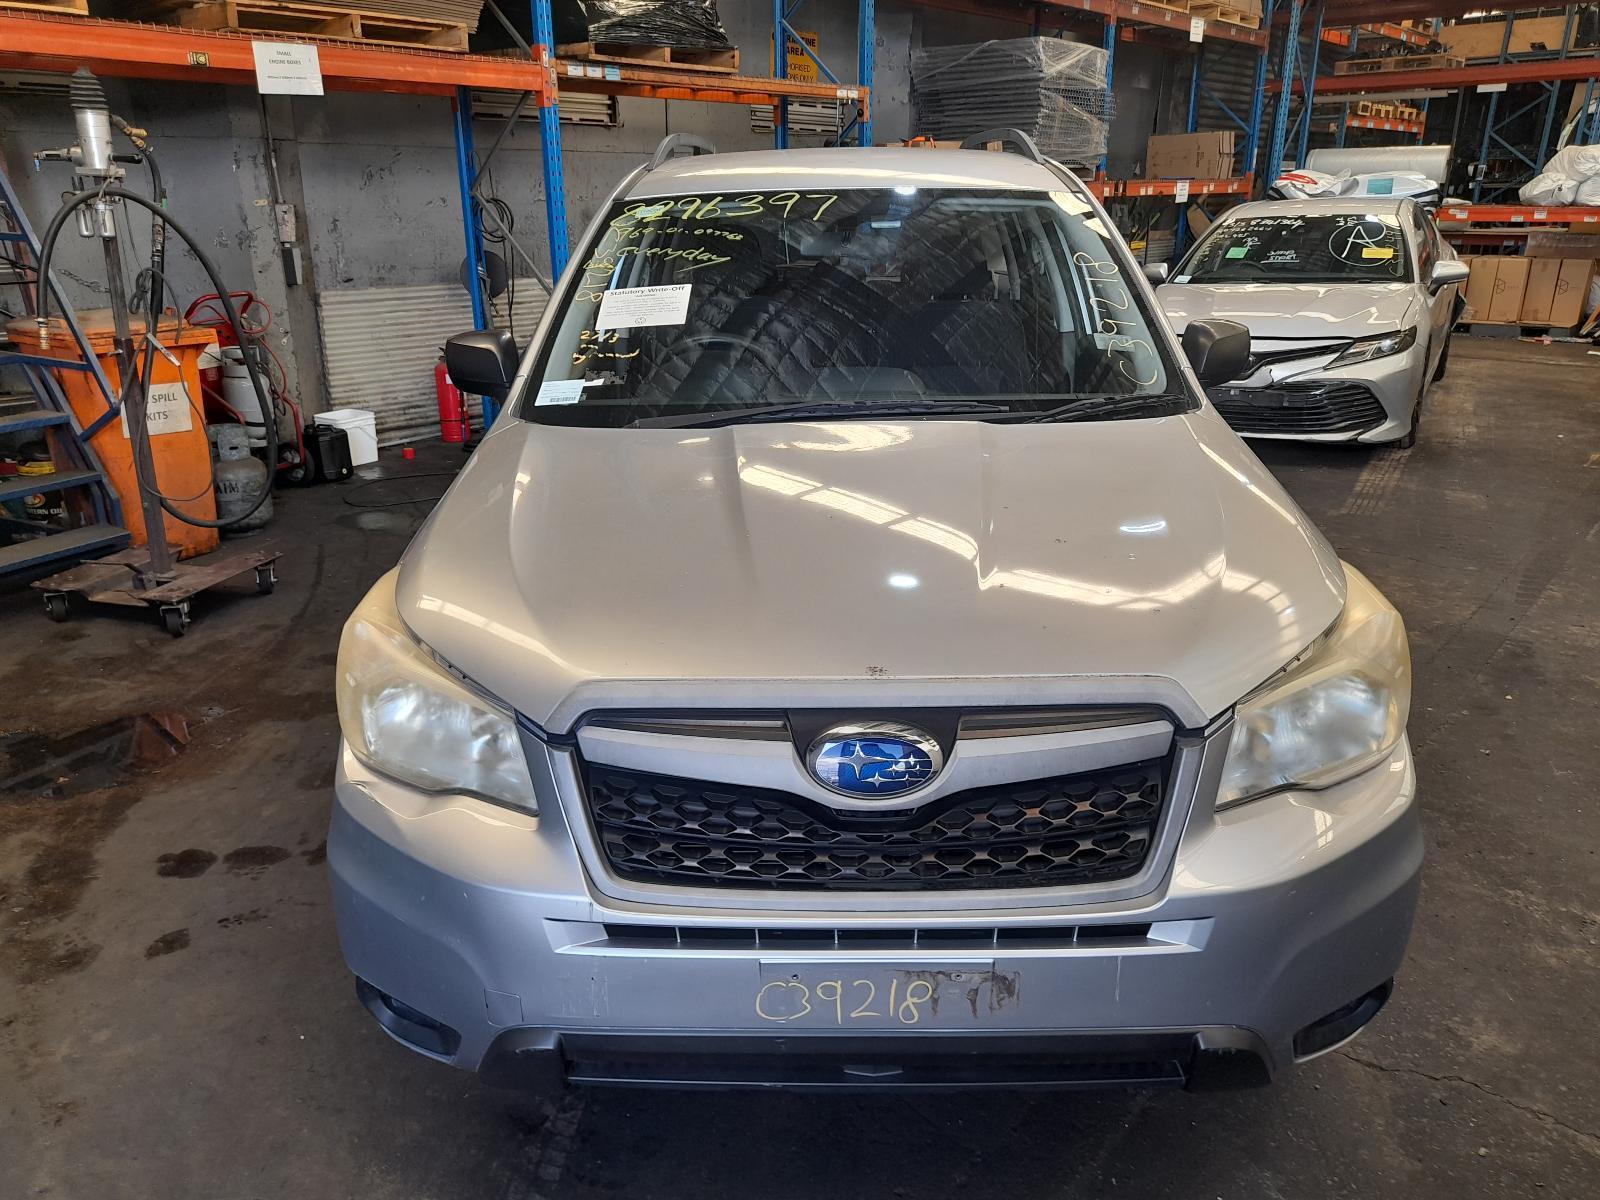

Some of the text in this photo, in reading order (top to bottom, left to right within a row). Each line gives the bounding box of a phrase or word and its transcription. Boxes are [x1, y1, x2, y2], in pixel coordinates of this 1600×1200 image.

[610, 289, 646, 297] Statutory
[647, 286, 685, 294] Write-Off
[151, 392, 178, 404] SPILL
[146, 411, 169, 422] KITS
[755, 978, 933, 1025] C39218
